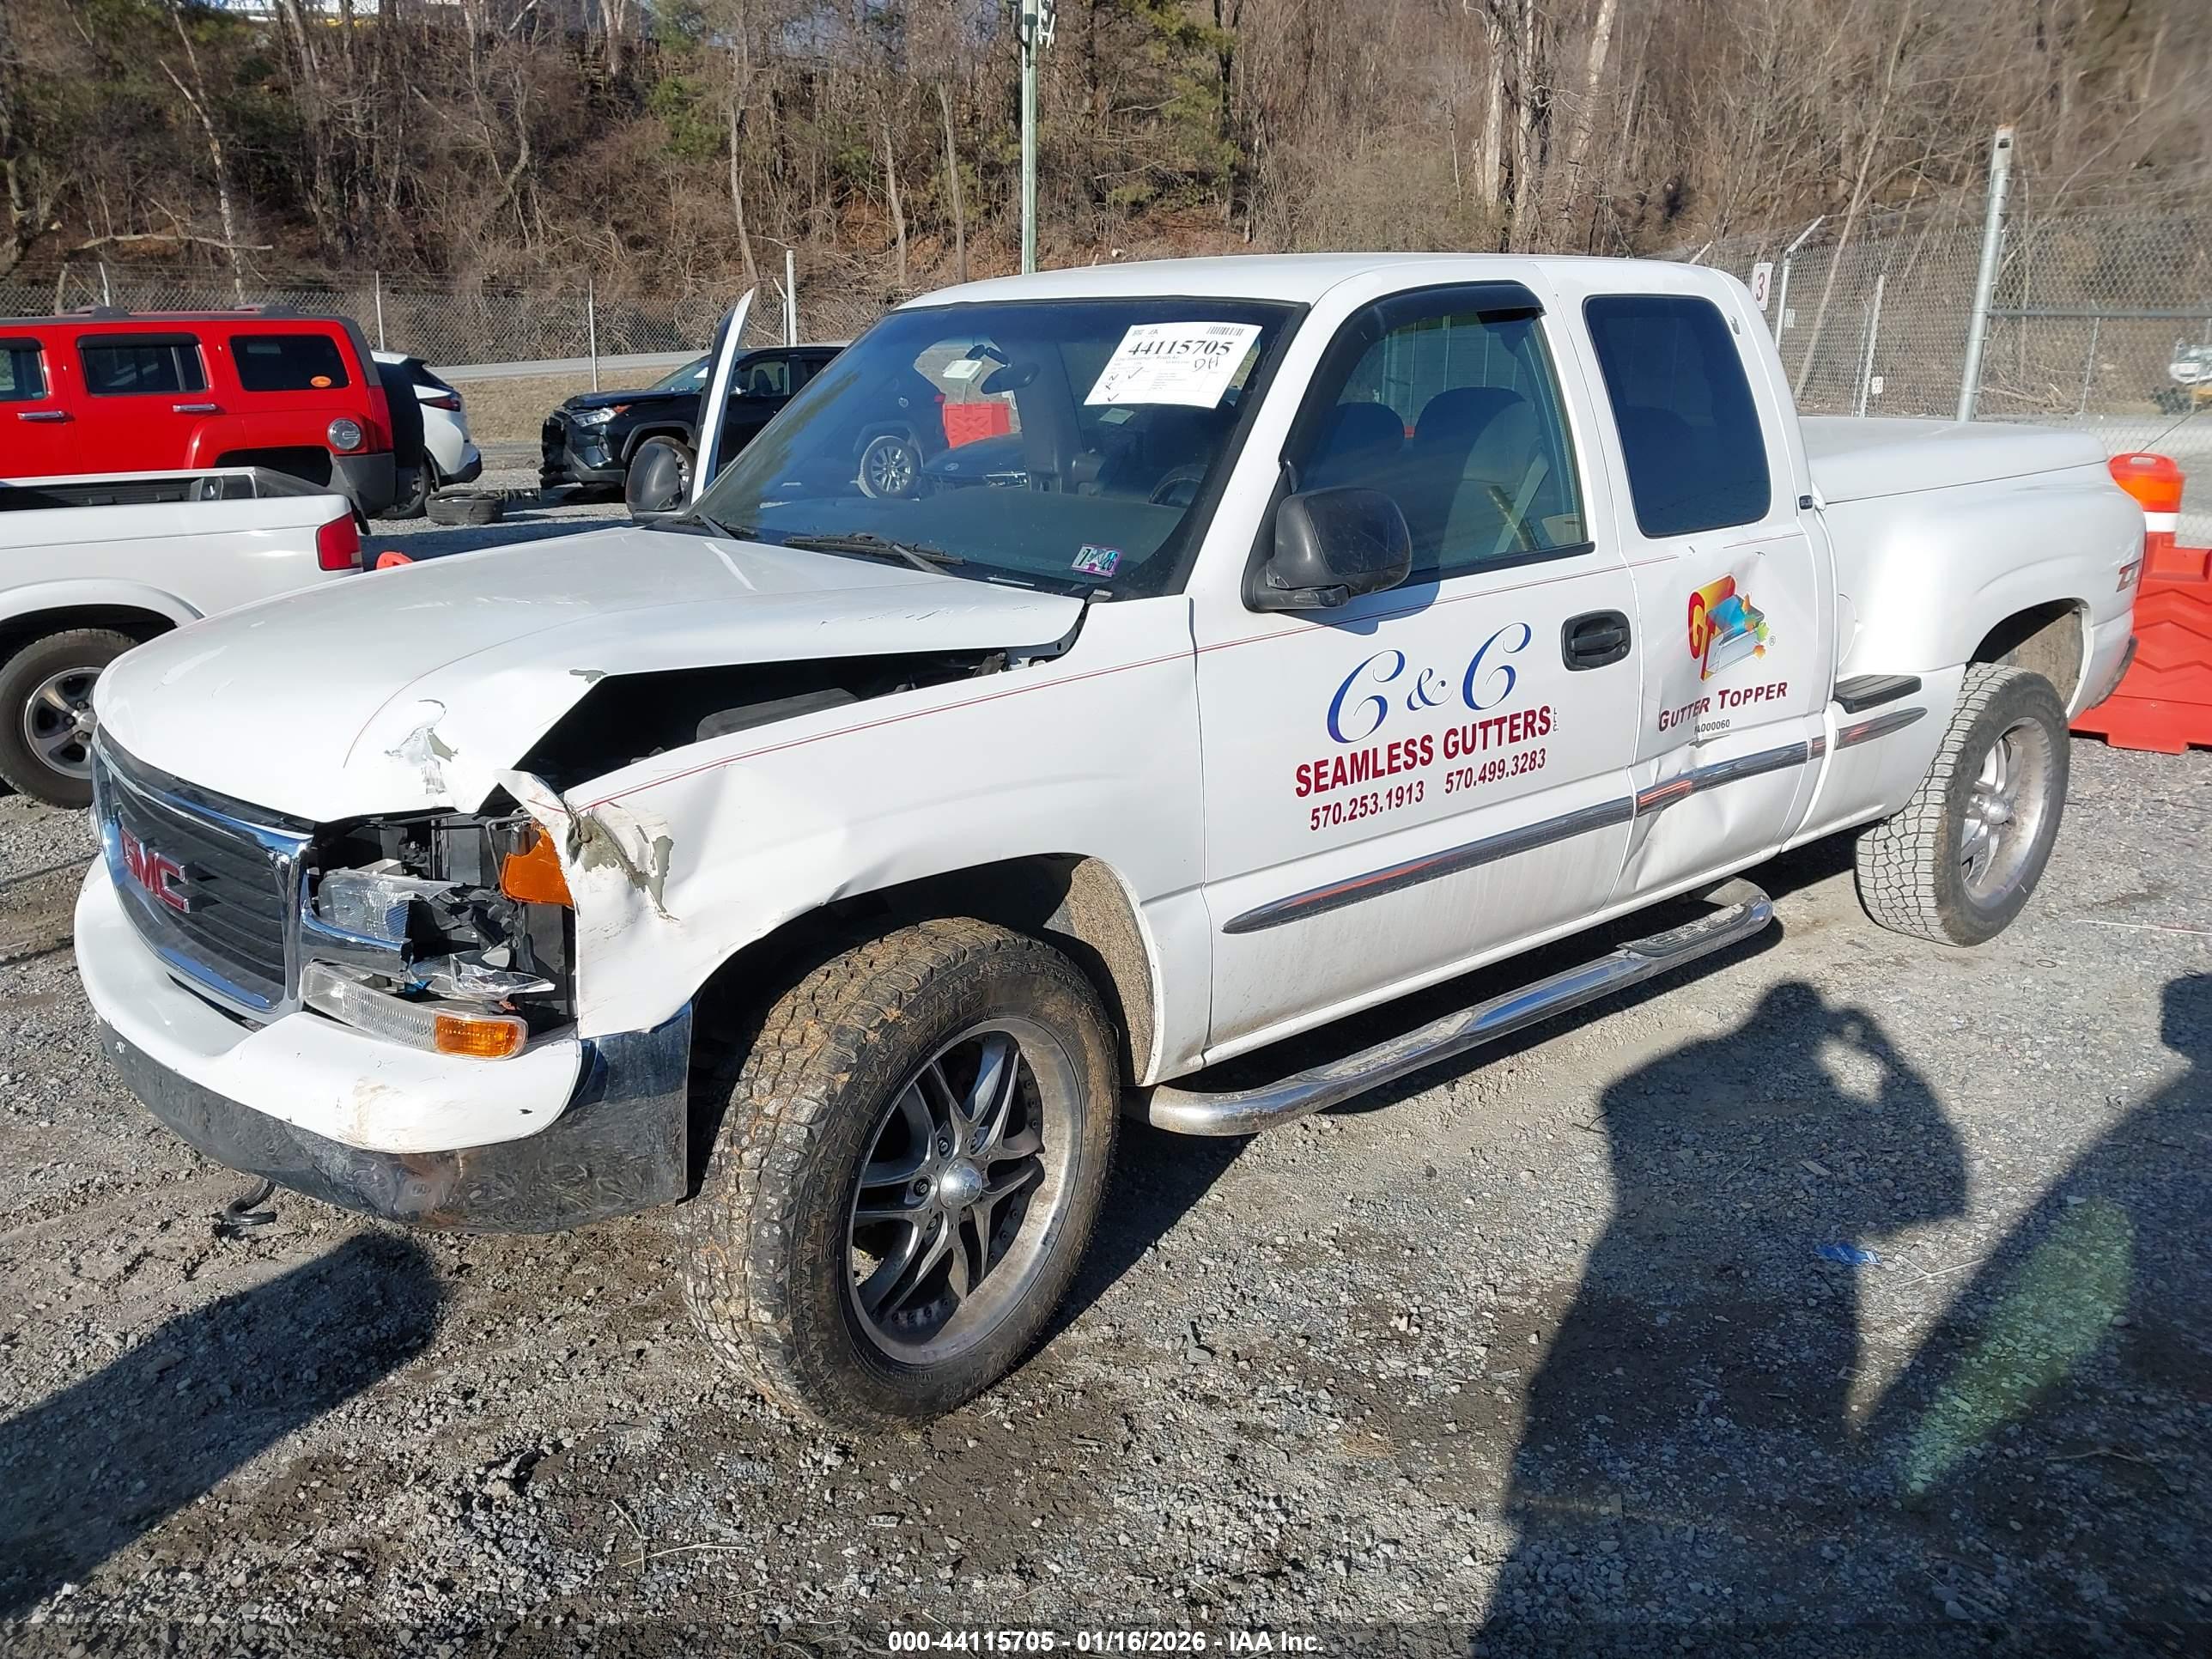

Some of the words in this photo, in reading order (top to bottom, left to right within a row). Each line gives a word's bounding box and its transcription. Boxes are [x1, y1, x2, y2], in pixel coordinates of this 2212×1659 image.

[1755, 271, 1765, 302] 3
[1128, 340, 1235, 356] 44115705
[1327, 649, 1406, 744] C
[1407, 667, 1454, 711] &
[1462, 622, 1532, 710] C
[1717, 681, 1788, 709] TOPPER
[1296, 734, 1434, 798] SEAMLESS
[1443, 705, 1551, 760] GUTTERS
[1310, 781, 1425, 830] 570.253.1913
[1445, 747, 1546, 794] 570.499.3283
[121, 827, 191, 913] GMC
